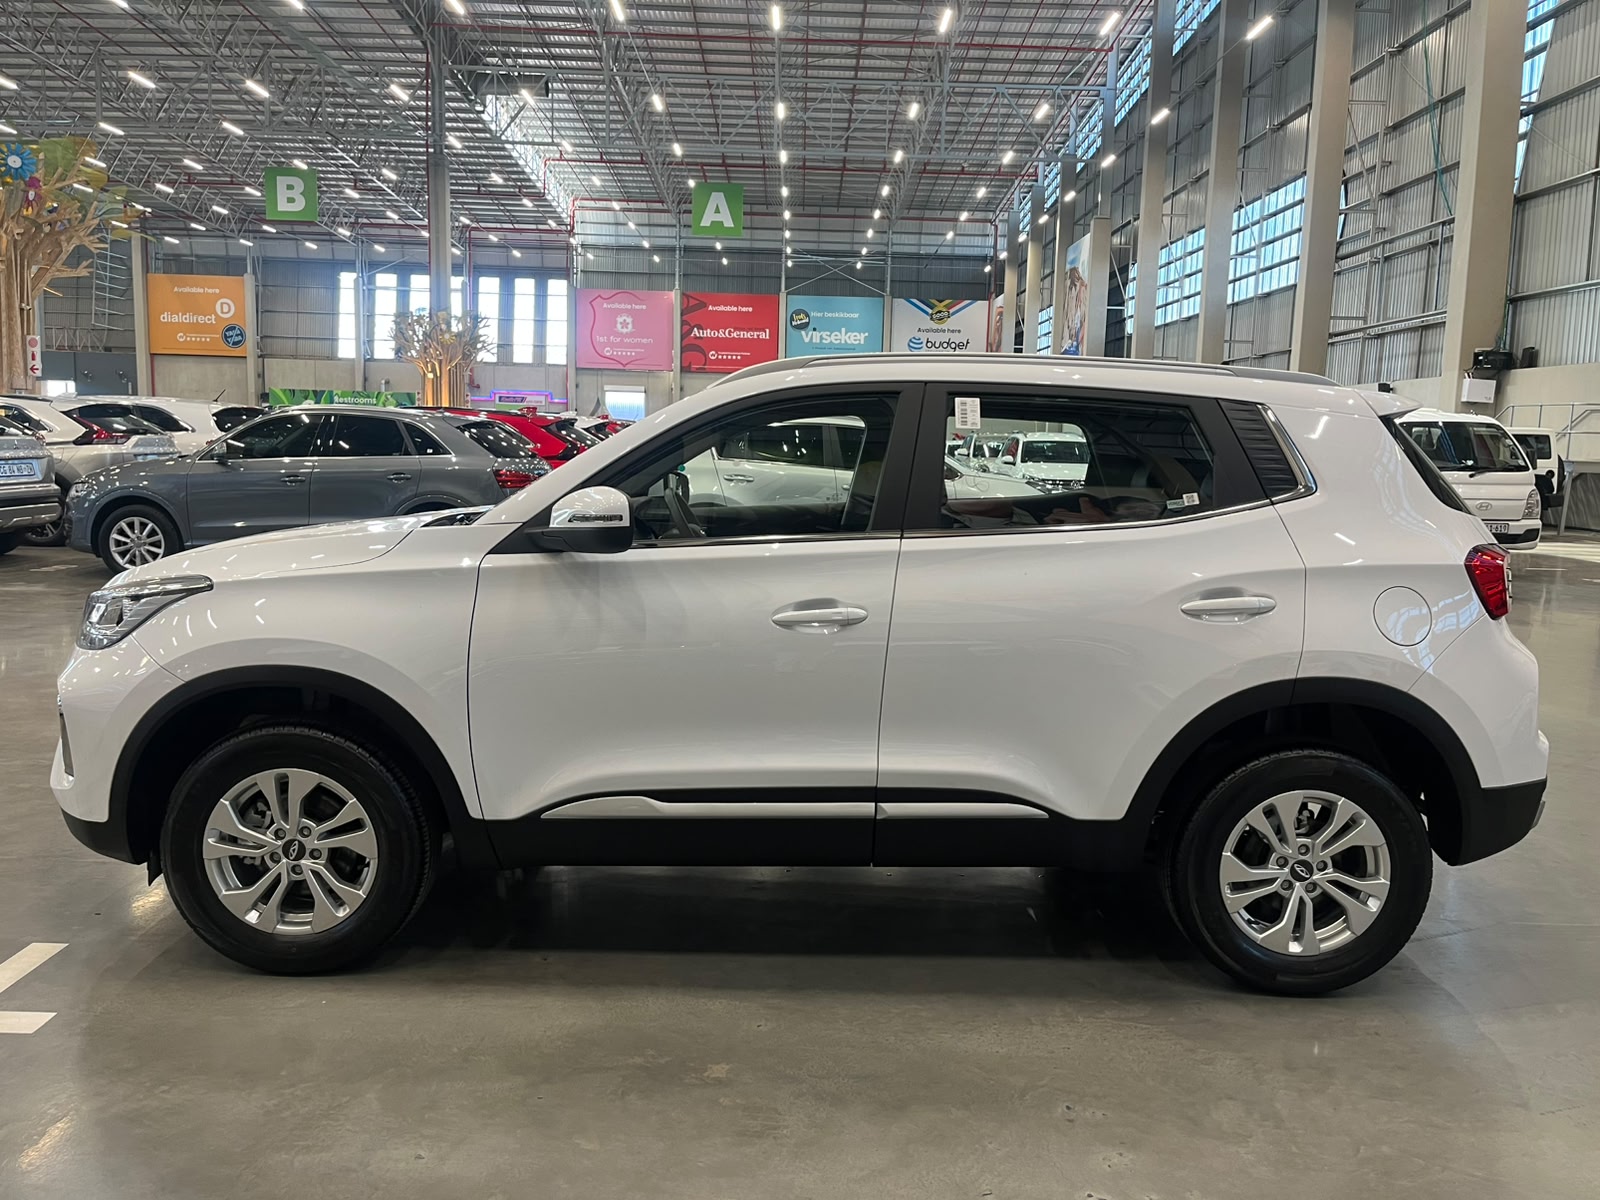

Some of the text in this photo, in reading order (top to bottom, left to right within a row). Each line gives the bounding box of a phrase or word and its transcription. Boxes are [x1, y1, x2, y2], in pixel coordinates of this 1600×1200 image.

[276, 176, 306, 212] B
[699, 192, 735, 228] A
[173, 286, 204, 294] Available
[220, 302, 231, 314] D
[160, 312, 216, 324] dialdirect
[690, 328, 770, 340] Auto&General
[800, 327, 869, 345] virseker
[926, 338, 970, 352] budget
[334, 395, 377, 404] Restrooms
